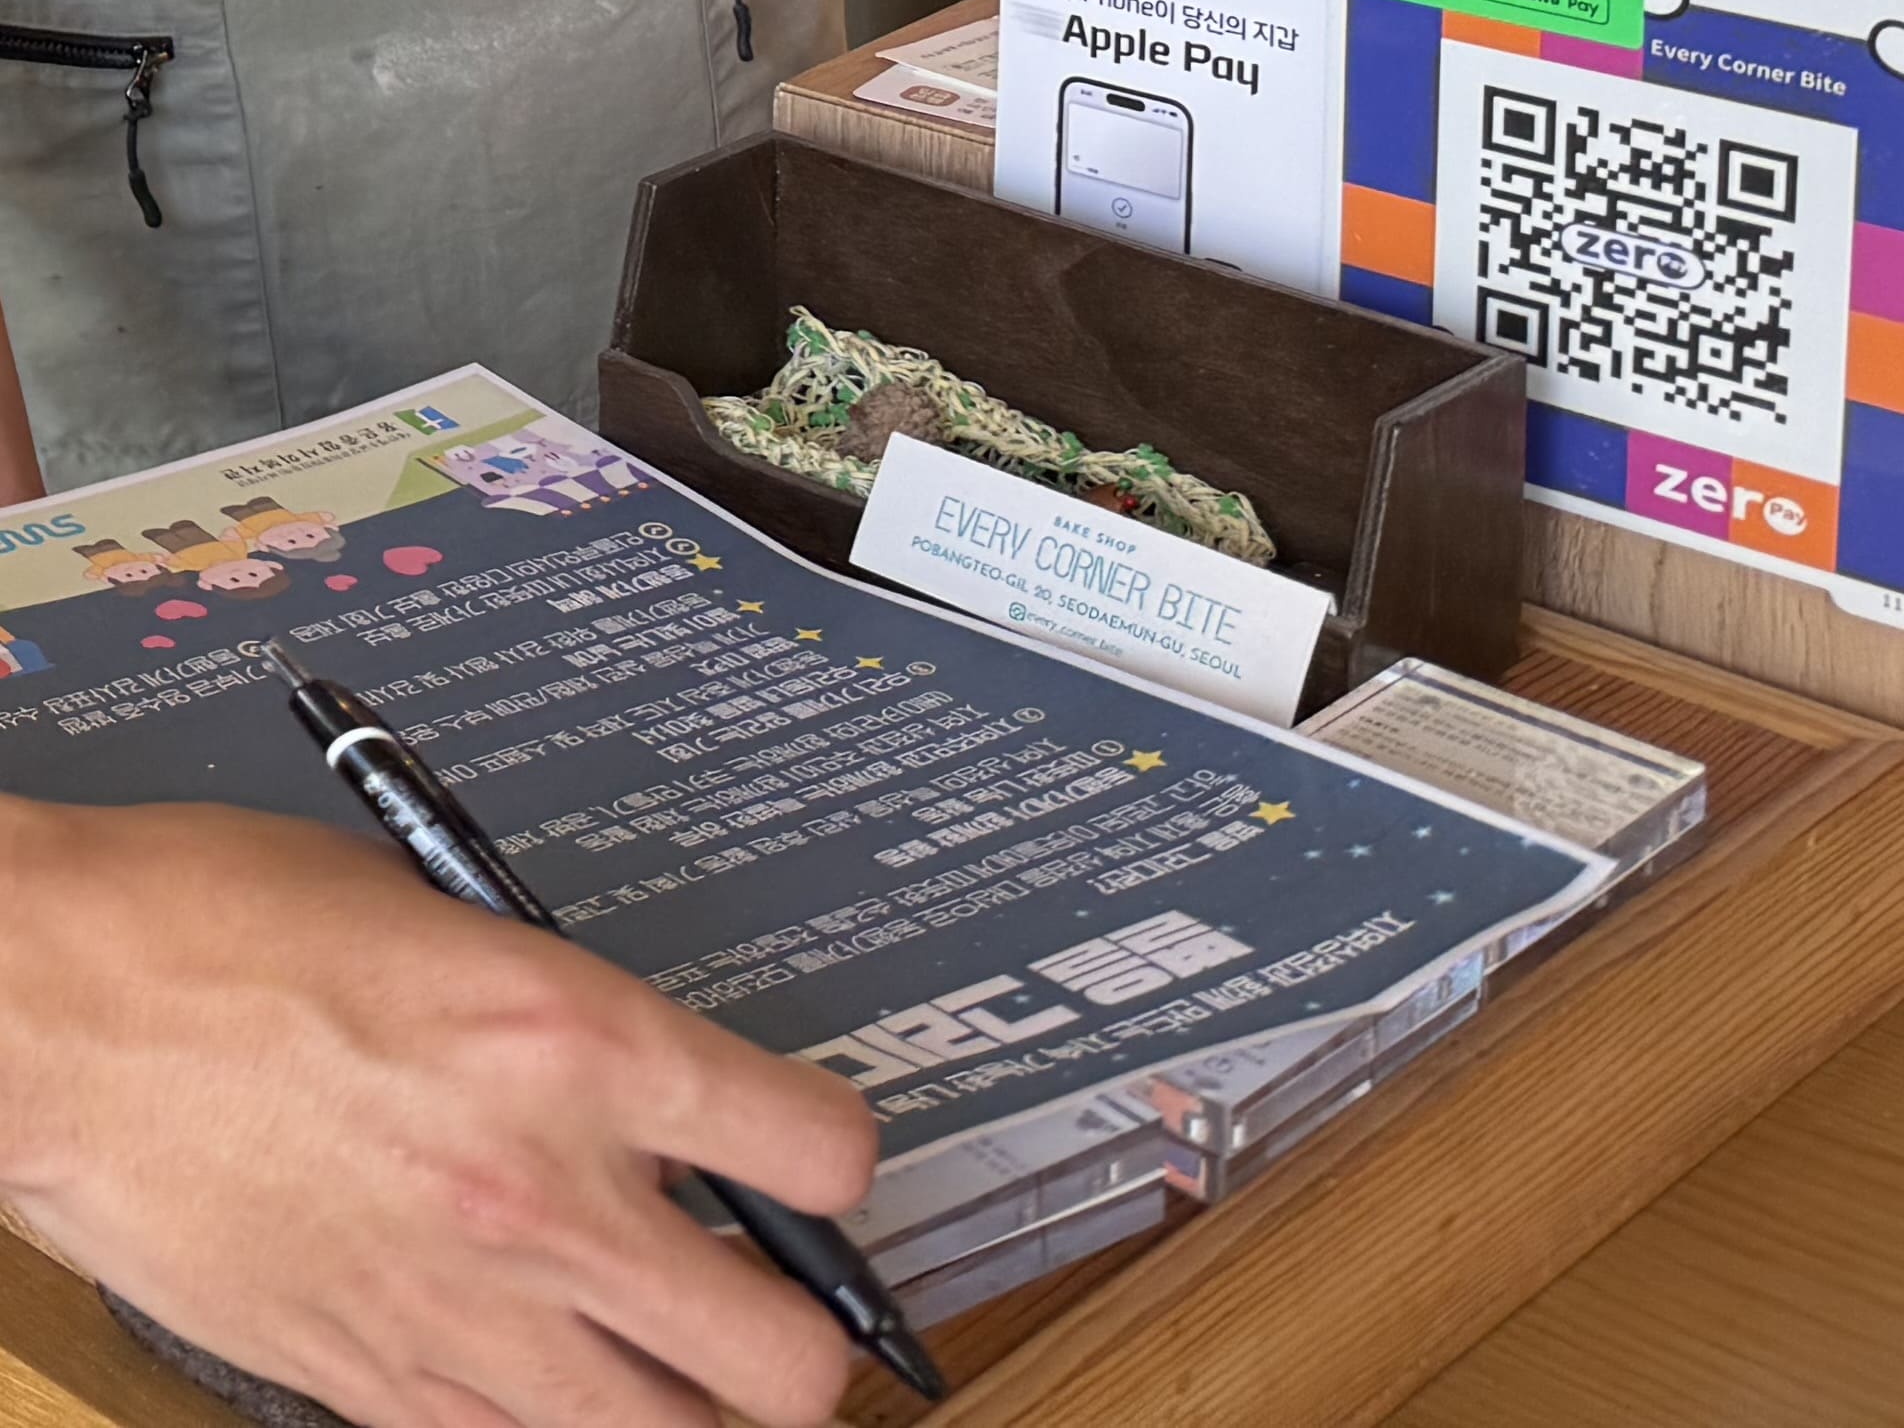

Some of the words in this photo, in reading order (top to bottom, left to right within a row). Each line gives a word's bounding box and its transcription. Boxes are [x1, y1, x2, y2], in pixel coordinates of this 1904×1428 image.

[1181, 4, 1248, 42] 당신의
[1253, 21, 1300, 52] 지갑
[1062, 13, 1171, 67] Apple
[1183, 41, 1261, 96] Pay
[1649, 39, 1713, 71] Every
[1717, 51, 1796, 85] Corner
[1799, 70, 1848, 96] Bite
[1053, 515, 1091, 540] BAKE
[1096, 533, 1138, 555] SHOP
[543, 571, 585, 589] 내
[567, 545, 674, 582] 지역사회
[590, 562, 697, 599] 동행가게
[934, 494, 1033, 562] EVERY
[1034, 535, 1152, 606] CORNER
[1157, 588, 1243, 647] BITE
[473, 578, 561, 610] 따뜻한
[540, 588, 608, 613] 혜택
[911, 534, 1029, 596] POBANGTEO-GIL
[1034, 586, 1054, 607] 20,
[1058, 593, 1186, 659] SEODAEMUN-GU,
[1190, 651, 1243, 680] SEOUL
[351, 621, 417, 647] 홍보
[400, 600, 489, 632] 가게로
[685, 651, 753, 677] 마켓
[734, 634, 801, 659] 별별
[132, 647, 245, 688] 동행가게
[847, 669, 919, 696] 우리
[38, 675, 147, 716] 감사표창
[775, 686, 868, 720] 가게를
[700, 709, 796, 745] 알리는
[883, 716, 1029, 769] 지역주민과
[649, 734, 723, 764] 기회
[787, 758, 908, 804] 함께하는
[1006, 749, 1108, 788] 따뜻한
[904, 795, 978, 825] 활동
[957, 777, 1030, 806] 나눔
[990, 763, 1144, 821] 동행가게가
[714, 793, 808, 830] 특별한
[660, 819, 733, 850] 하루
[864, 837, 942, 869] 활동
[1189, 819, 1271, 852] 별을
[1076, 841, 1216, 895] 그리다란?
[1018, 907, 1262, 1011] 별을
[1233, 907, 1435, 988] 지역상점과
[1187, 973, 1277, 1012] 함께
[1095, 995, 1214, 1046] 만드는
[1032, 1029, 1117, 1067] 지속
[939, 1048, 1051, 1097] 가능한
